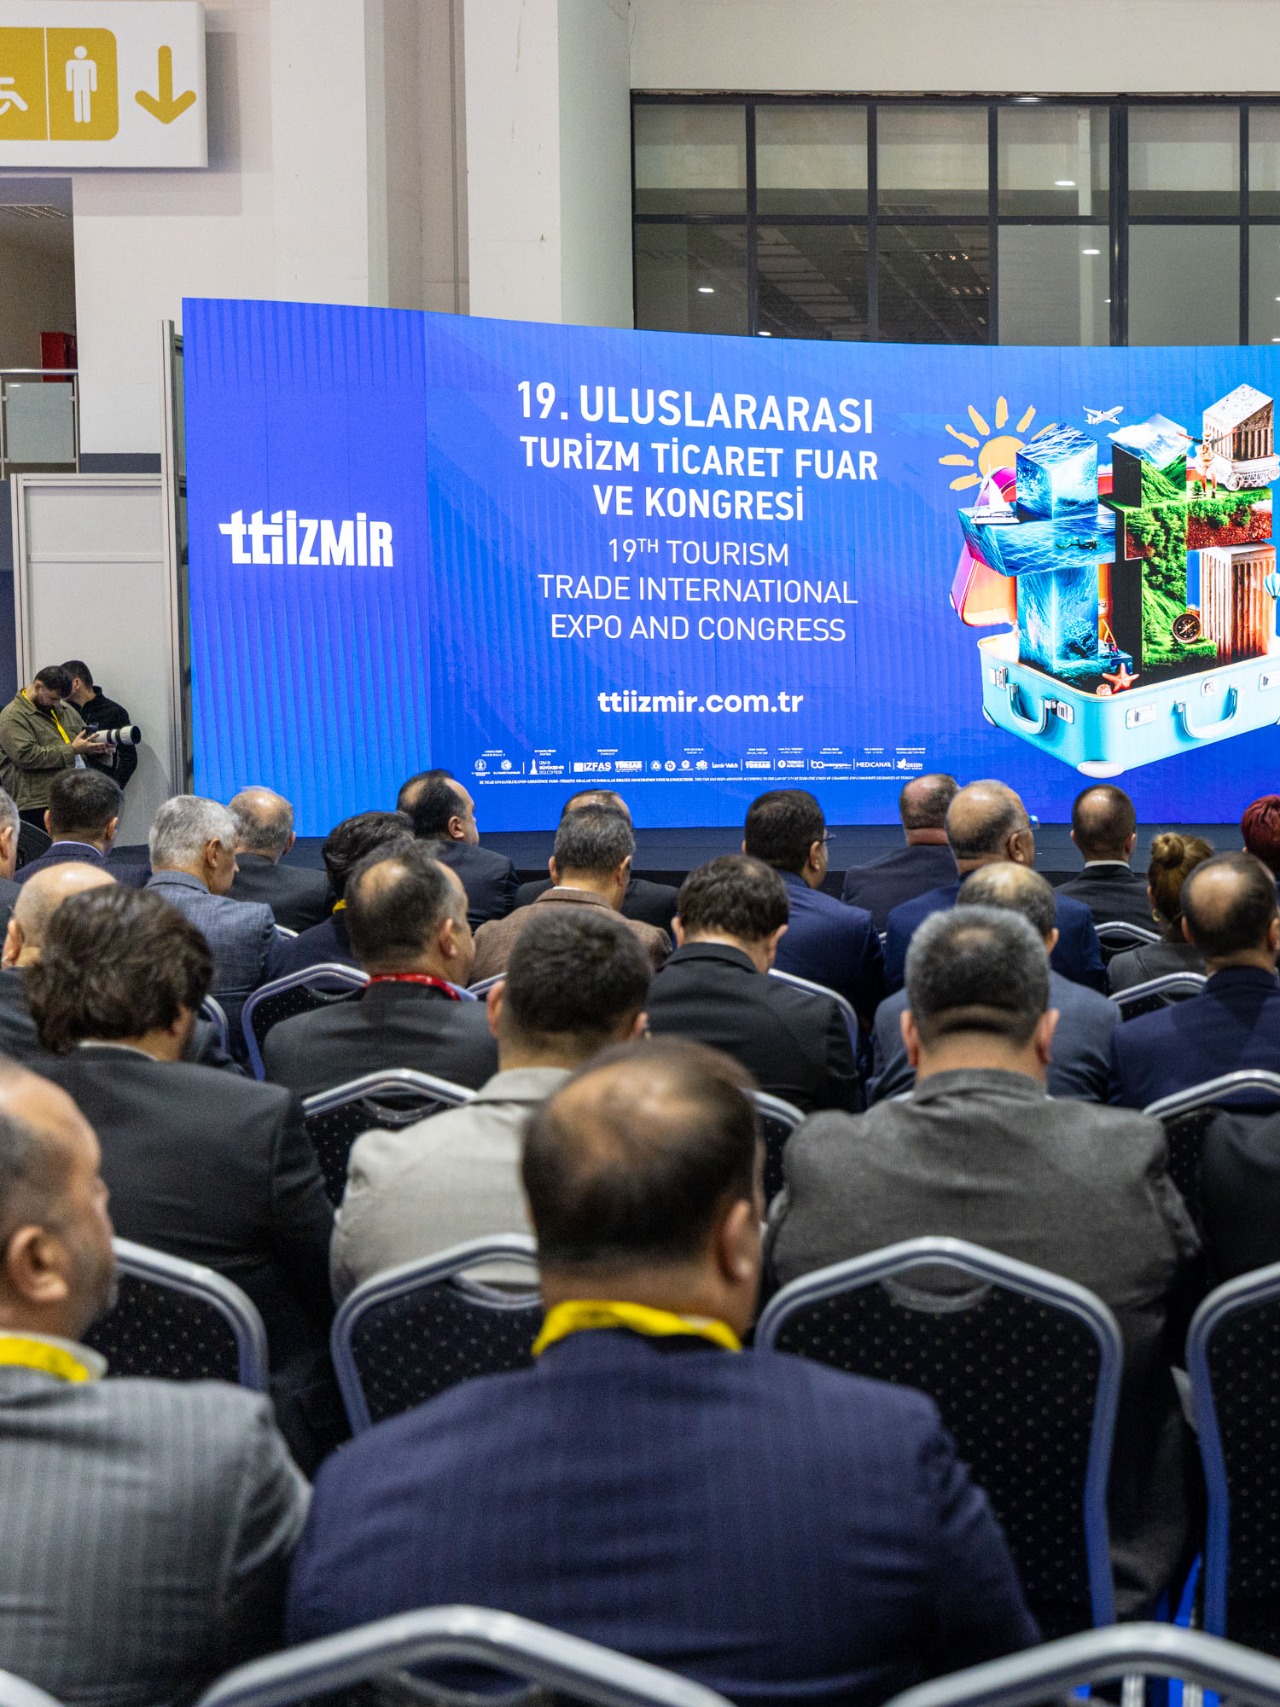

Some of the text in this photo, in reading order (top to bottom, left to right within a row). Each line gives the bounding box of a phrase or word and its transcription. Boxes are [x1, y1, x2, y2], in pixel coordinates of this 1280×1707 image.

[518, 381, 873, 434] 19. ULUSLARARASI
[519, 432, 878, 481] TURİZM TİCARET FUAR
[593, 485, 804, 521] VE KONGRESİ
[609, 538, 789, 567] 19TH TOURISM
[538, 574, 859, 604] TRADE INTERNATIONAL
[551, 614, 846, 642] EXPO AND CONGRESS
[597, 689, 804, 713] ttiizmir.com.tr
